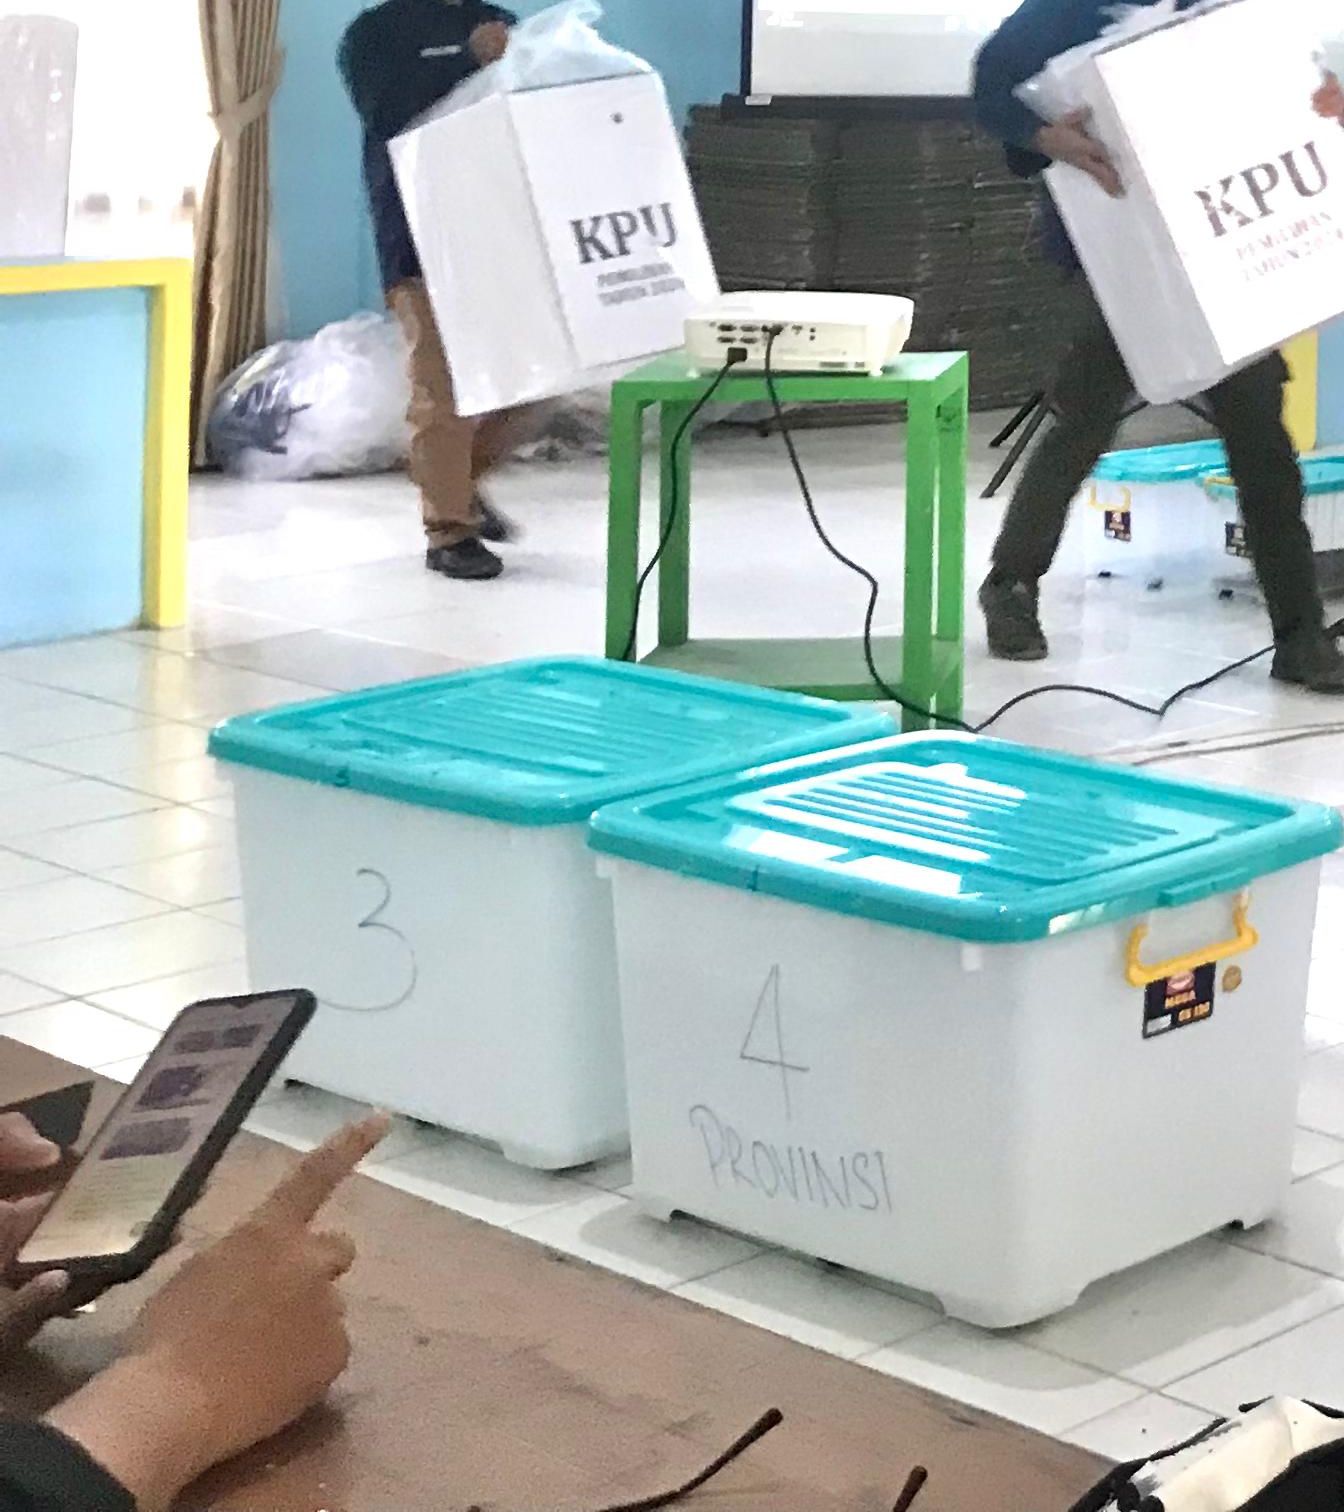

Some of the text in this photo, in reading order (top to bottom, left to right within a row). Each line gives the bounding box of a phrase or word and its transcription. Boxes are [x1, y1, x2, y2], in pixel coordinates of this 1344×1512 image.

[569, 202, 678, 264] KPU
[1193, 141, 1328, 238] KPU
[316, 867, 418, 1012] 3
[739, 963, 810, 1121] 4
[688, 1104, 893, 1215] PROVINSI
